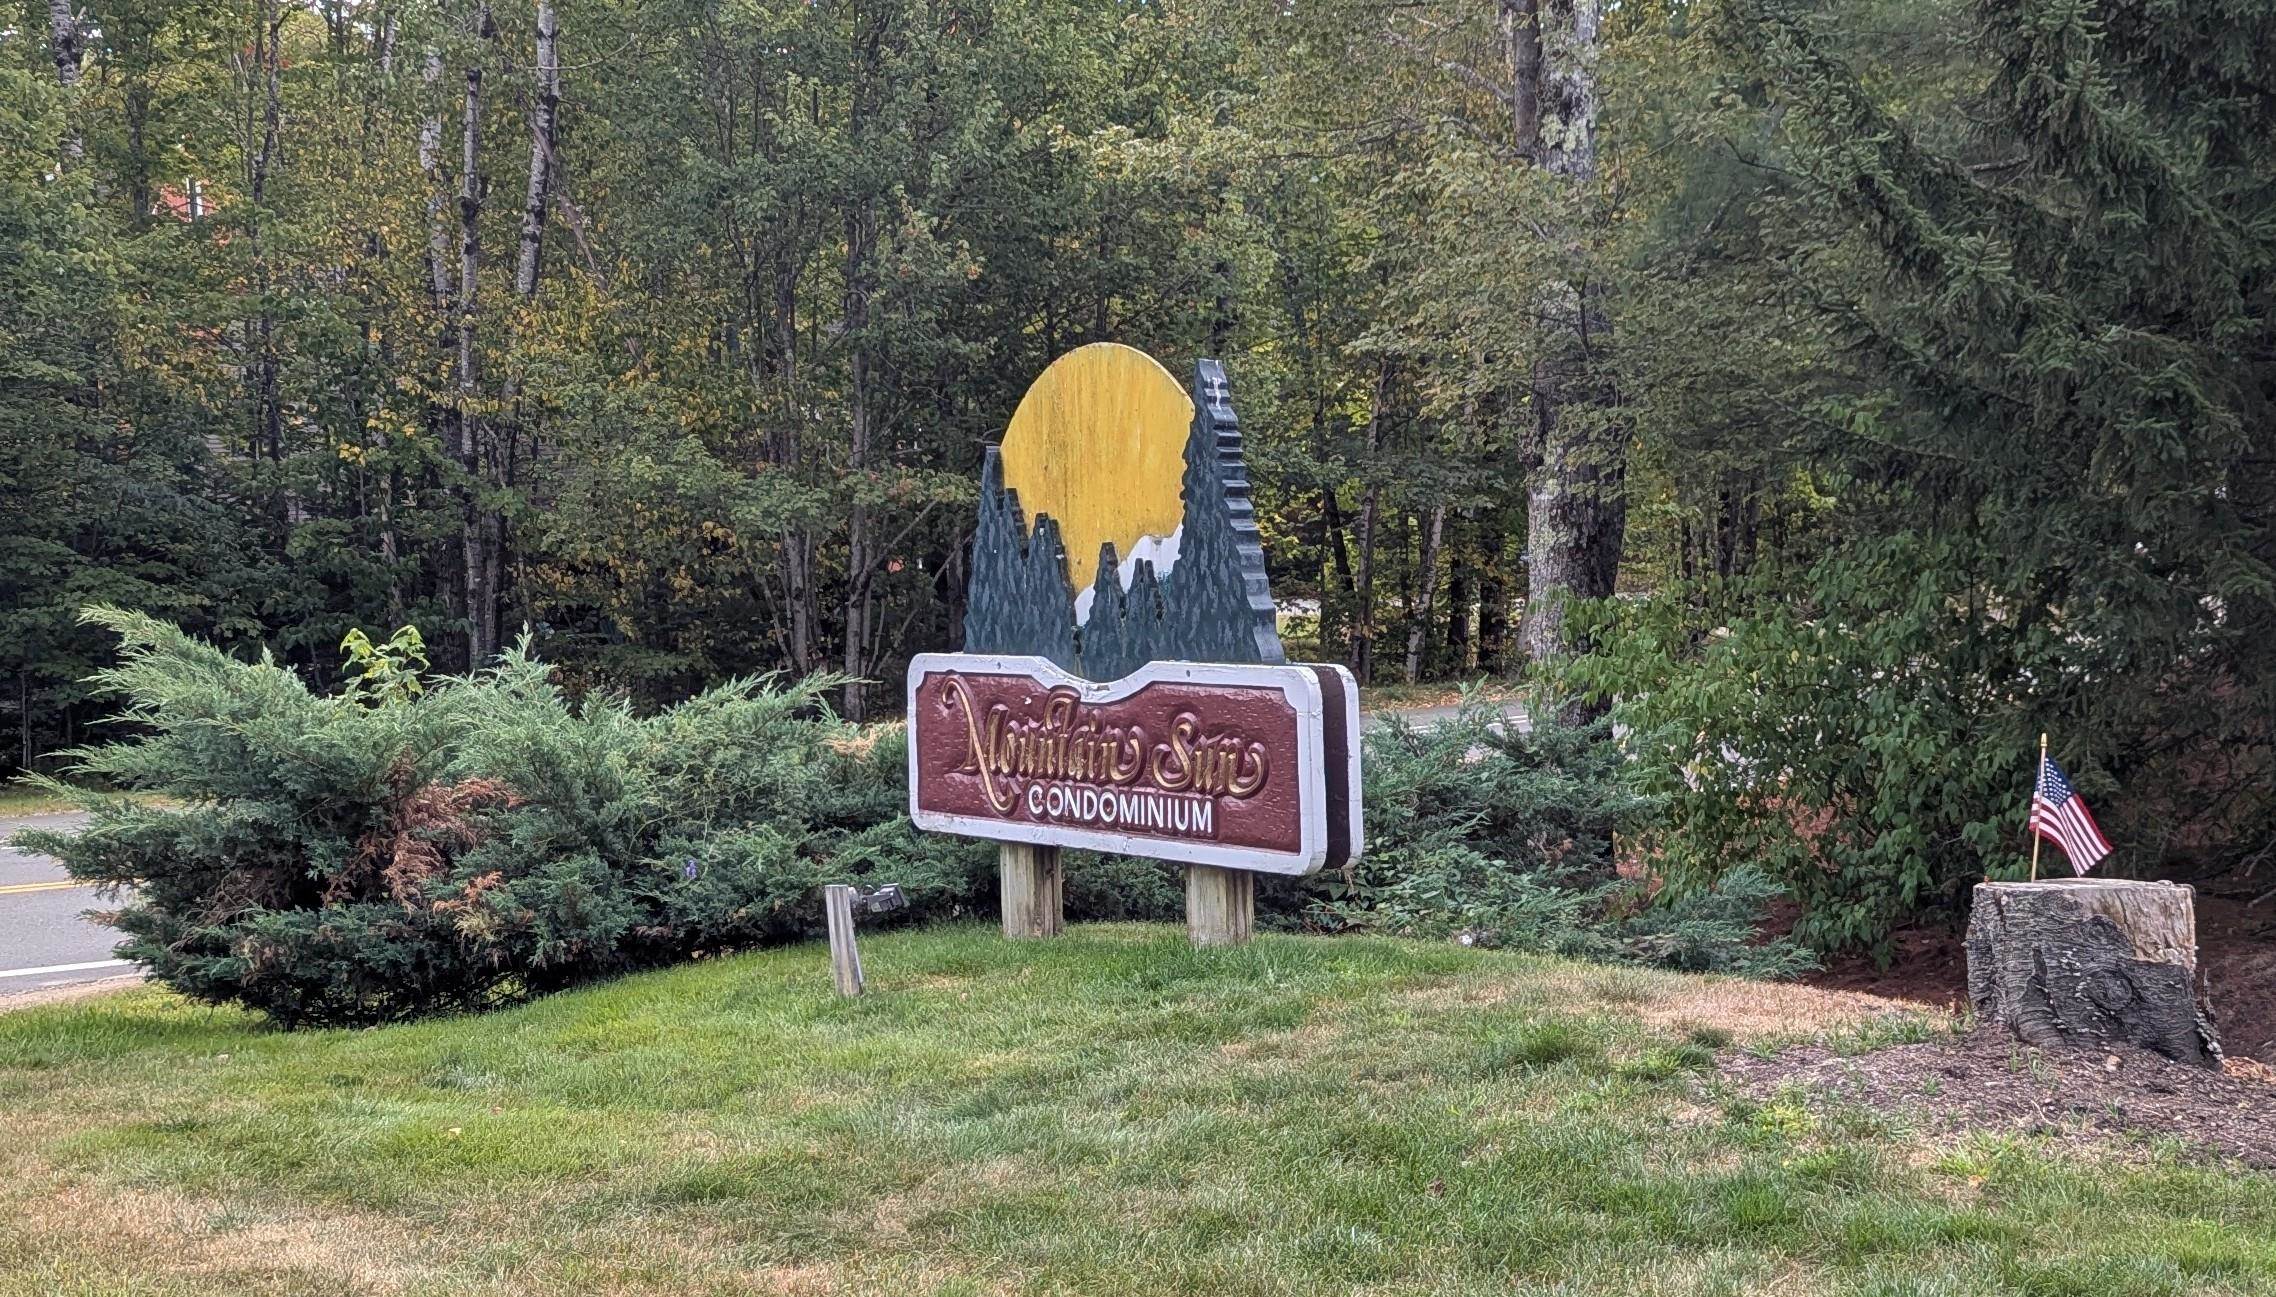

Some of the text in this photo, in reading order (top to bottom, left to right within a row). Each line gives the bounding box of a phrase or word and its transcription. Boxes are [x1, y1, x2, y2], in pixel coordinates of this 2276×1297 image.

[941, 673, 1267, 814] Mountain Sun
[1027, 784, 1213, 834] CONDOMINIUM
